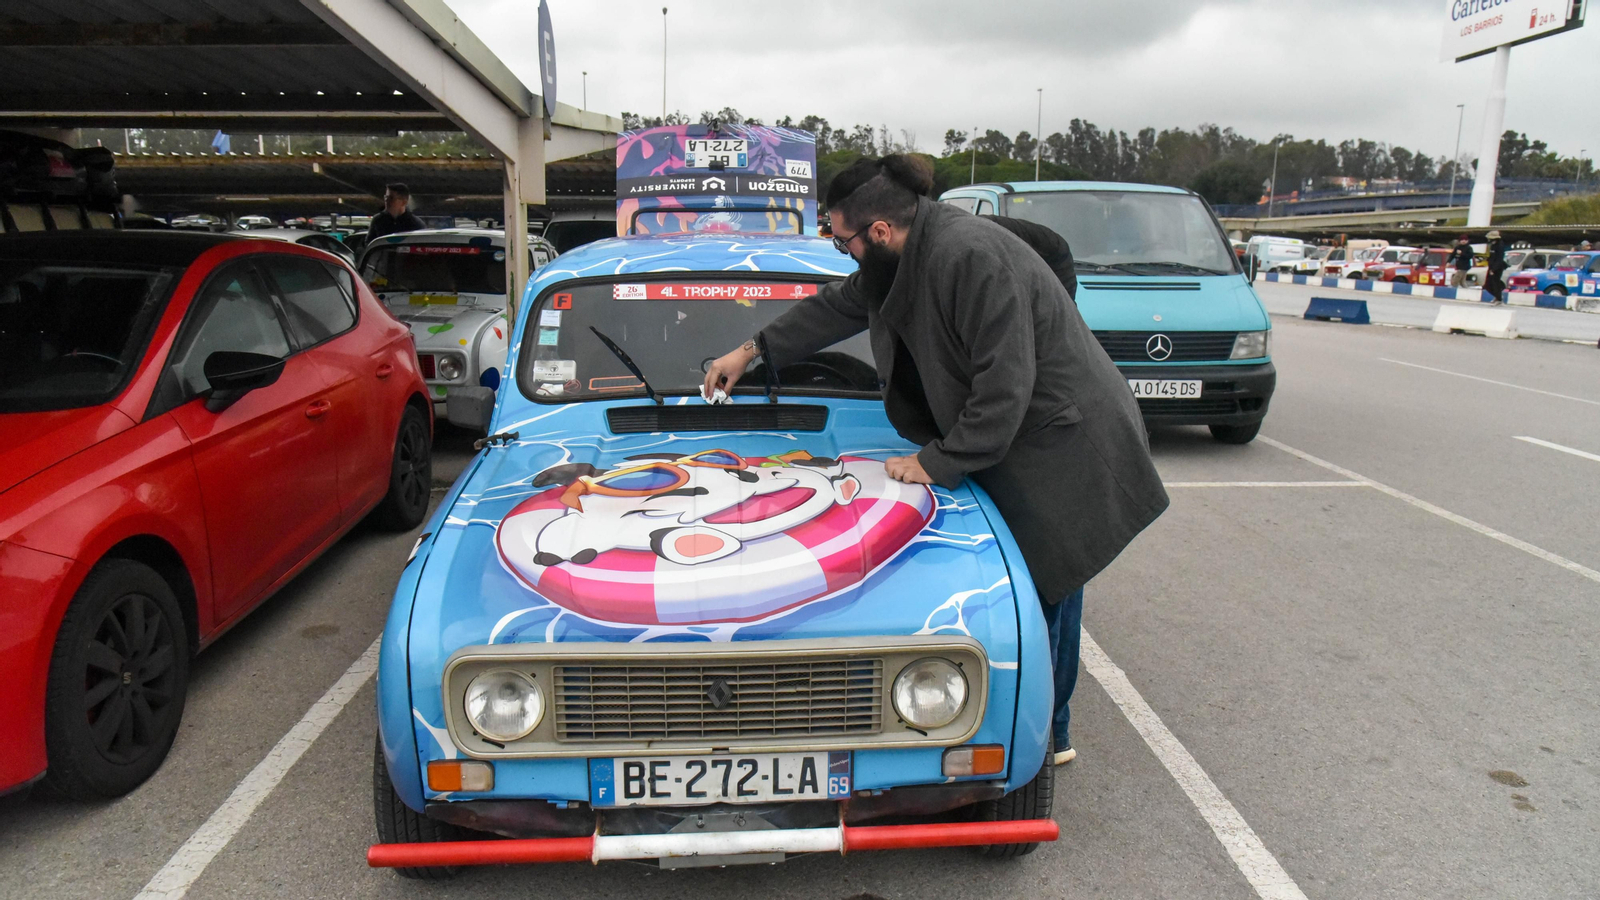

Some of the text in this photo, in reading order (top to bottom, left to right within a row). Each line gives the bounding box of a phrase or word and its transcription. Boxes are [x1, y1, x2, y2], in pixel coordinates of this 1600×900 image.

[1460, 14, 1503, 37] LOS BARRIOS
[1539, 14, 1548, 26] 24
[543, 30, 553, 85] E
[688, 140, 744, 152] 272-LA
[790, 166, 808, 176] 779
[630, 183, 695, 193] UNIVERSITY
[748, 179, 809, 194] amazon
[660, 286, 772, 297] 4L TROPHY 2023
[557, 295, 568, 308] F
[1133, 381, 1196, 395] A 0145 DS
[623, 756, 819, 799] BE-272-LA
[829, 777, 849, 795] 69
[598, 787, 607, 799] F
